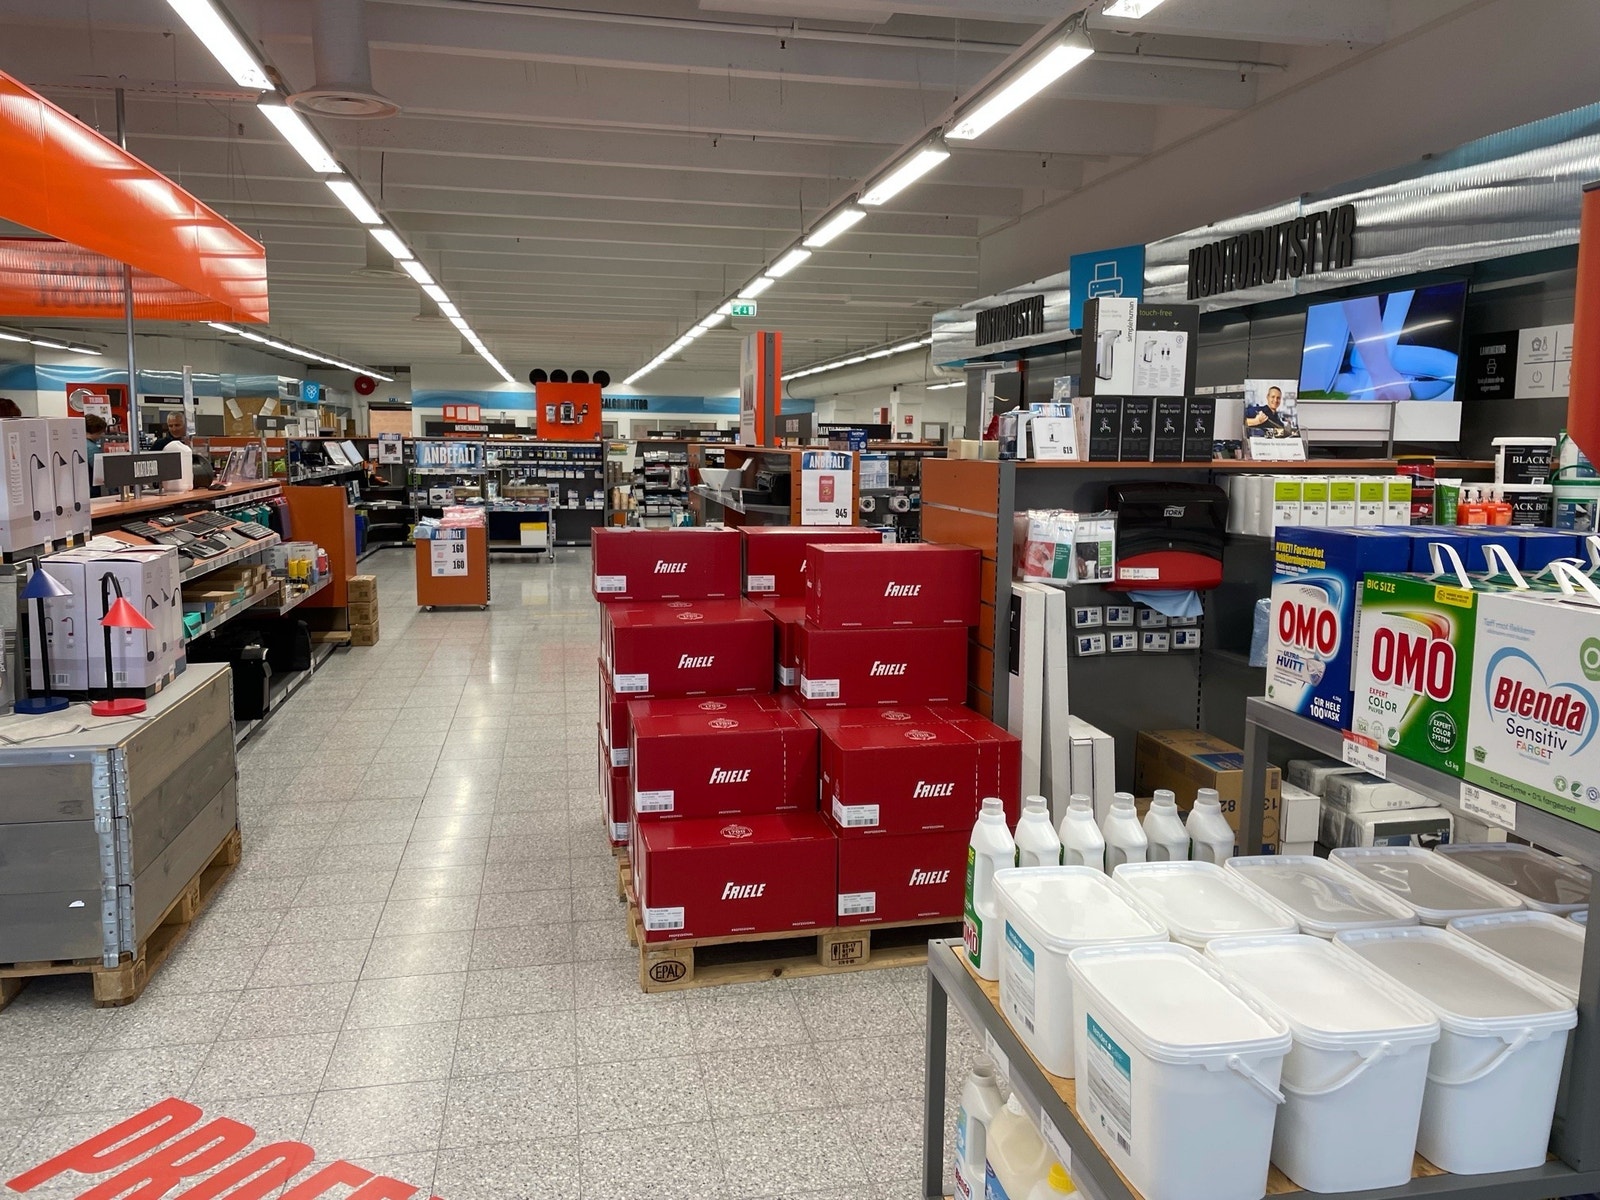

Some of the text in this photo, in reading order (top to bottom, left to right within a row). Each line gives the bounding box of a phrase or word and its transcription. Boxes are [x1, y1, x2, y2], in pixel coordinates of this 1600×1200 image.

[1187, 204, 1356, 300] KONTORUTSTYR
[1139, 309, 1173, 317] touch-free
[975, 294, 1045, 348] KONTORUTSTYR
[1127, 301, 1135, 343] simplehuman
[424, 447, 477, 464] ANBEFALT
[1063, 446, 1073, 455] 619
[809, 455, 846, 469] ANBEFALT
[1512, 455, 1545, 464] BLACK
[835, 508, 848, 519] 945
[1165, 507, 1184, 517] TORK
[1512, 502, 1533, 511] ACK
[435, 530, 462, 540] ANBEFALT
[452, 543, 464, 553] 160
[453, 560, 465, 570] 160
[654, 559, 688, 574] FRIELE
[884, 581, 922, 597] FRIELE
[1366, 579, 1396, 593] BIG SIZE
[1279, 600, 1337, 654] OMO
[678, 653, 715, 669] FRIELE
[1283, 650, 1300, 660] ULTRA
[870, 660, 908, 676] FRIELE
[1276, 654, 1305, 672] HVITT
[1371, 627, 1455, 700] OMO
[1369, 687, 1388, 698] EXPERT
[1325, 700, 1341, 713] HELE
[1368, 696, 1398, 713] COLOR
[1493, 676, 1587, 732] Blenda
[1310, 705, 1340, 722] 100 VASK
[1432, 726, 1451, 738] COLOR
[1433, 719, 1452, 731] EXPERT
[1431, 733, 1451, 745] SYSTEM
[1506, 717, 1568, 751] Sensitiv
[1516, 740, 1554, 759] FARGET
[1453, 762, 1459, 772] kg
[709, 767, 751, 785] FRIELE
[913, 780, 955, 799] FRIELE
[1500, 782, 1527, 797] parfyme
[909, 868, 951, 887] FRIELE
[721, 881, 766, 900] FRIELE
[655, 967, 681, 979] EPAL
